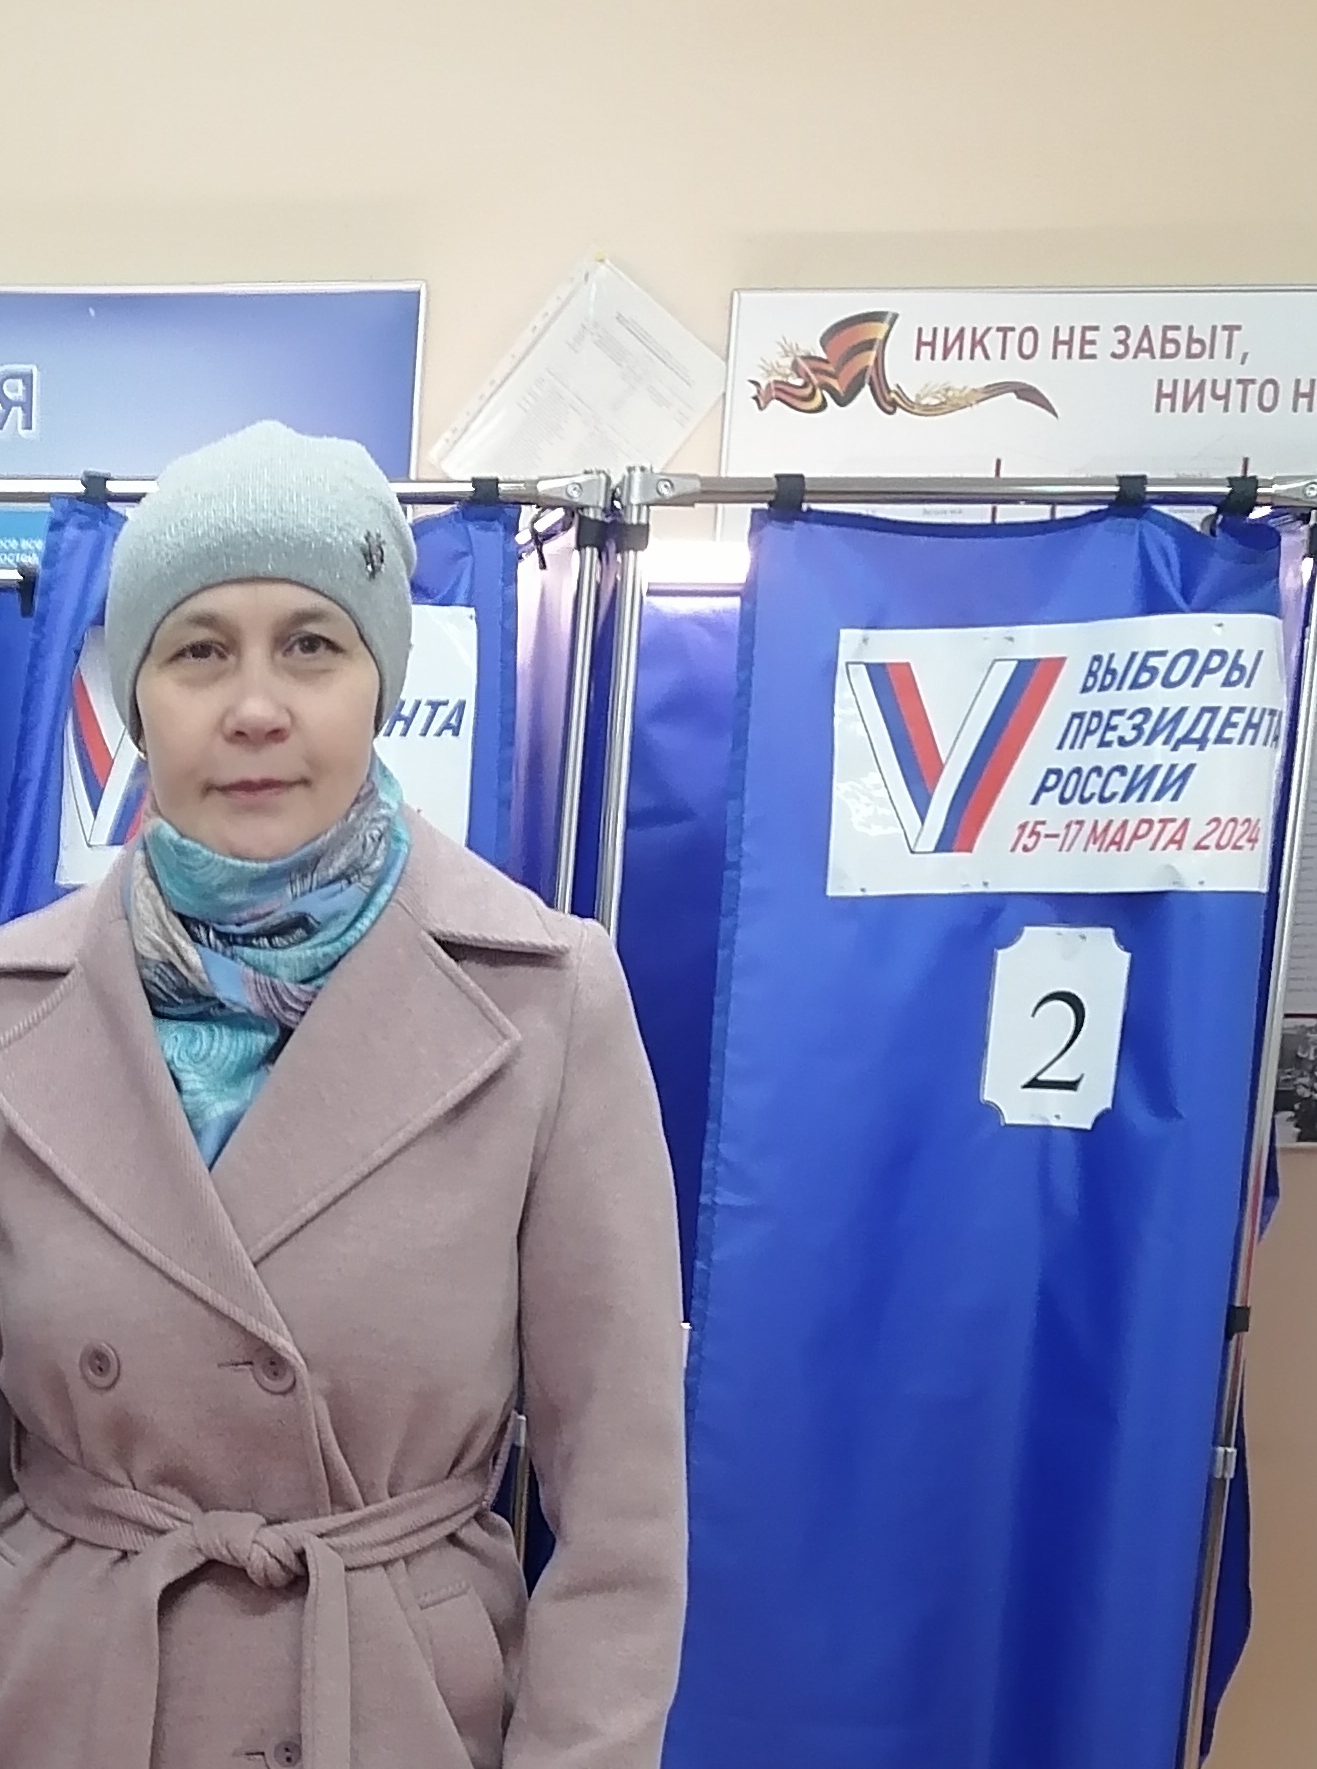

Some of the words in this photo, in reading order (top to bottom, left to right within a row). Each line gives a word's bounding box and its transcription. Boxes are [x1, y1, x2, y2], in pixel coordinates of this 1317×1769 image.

[914, 325, 1039, 362] НИКТО
[1051, 324, 1101, 361] НЕ
[1109, 324, 1250, 366] ЗАБЫТ,
[1154, 377, 1281, 414] НИЧТО
[1080, 648, 1265, 694] ВЫБОРЫ
[1056, 705, 1283, 752] ПРЕЗИДЕНТА
[1030, 762, 1198, 806] РОССИИ
[1082, 817, 1192, 852] МАРТА
[1193, 816, 1262, 852] 2024
[1020, 989, 1087, 1093] 2
